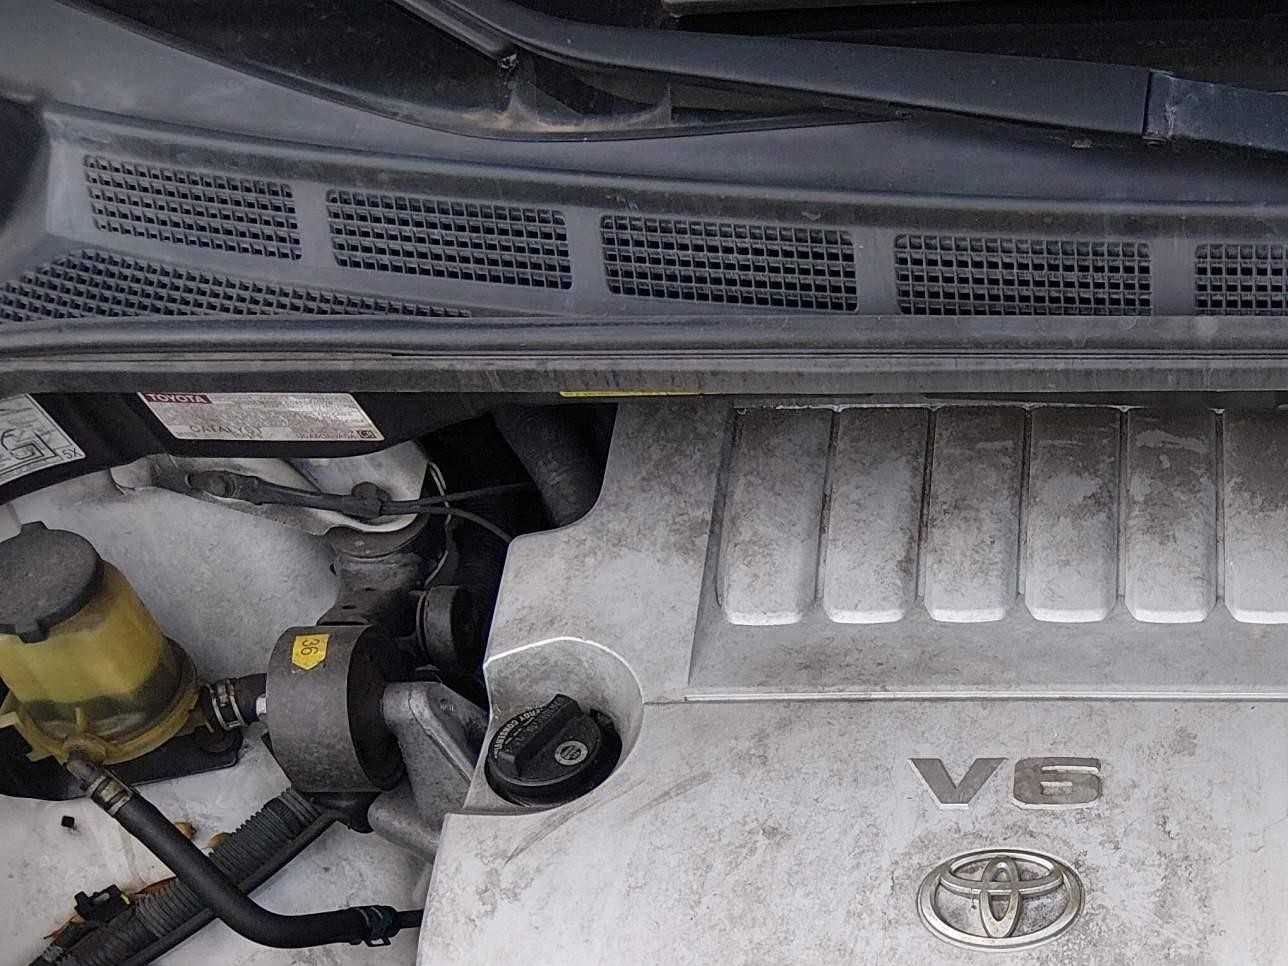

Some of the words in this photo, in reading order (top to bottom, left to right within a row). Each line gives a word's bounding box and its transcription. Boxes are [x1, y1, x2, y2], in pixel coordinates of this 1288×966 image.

[150, 393, 207, 404] TOYOTA
[301, 638, 320, 656] 36
[907, 756, 1102, 810] V6
